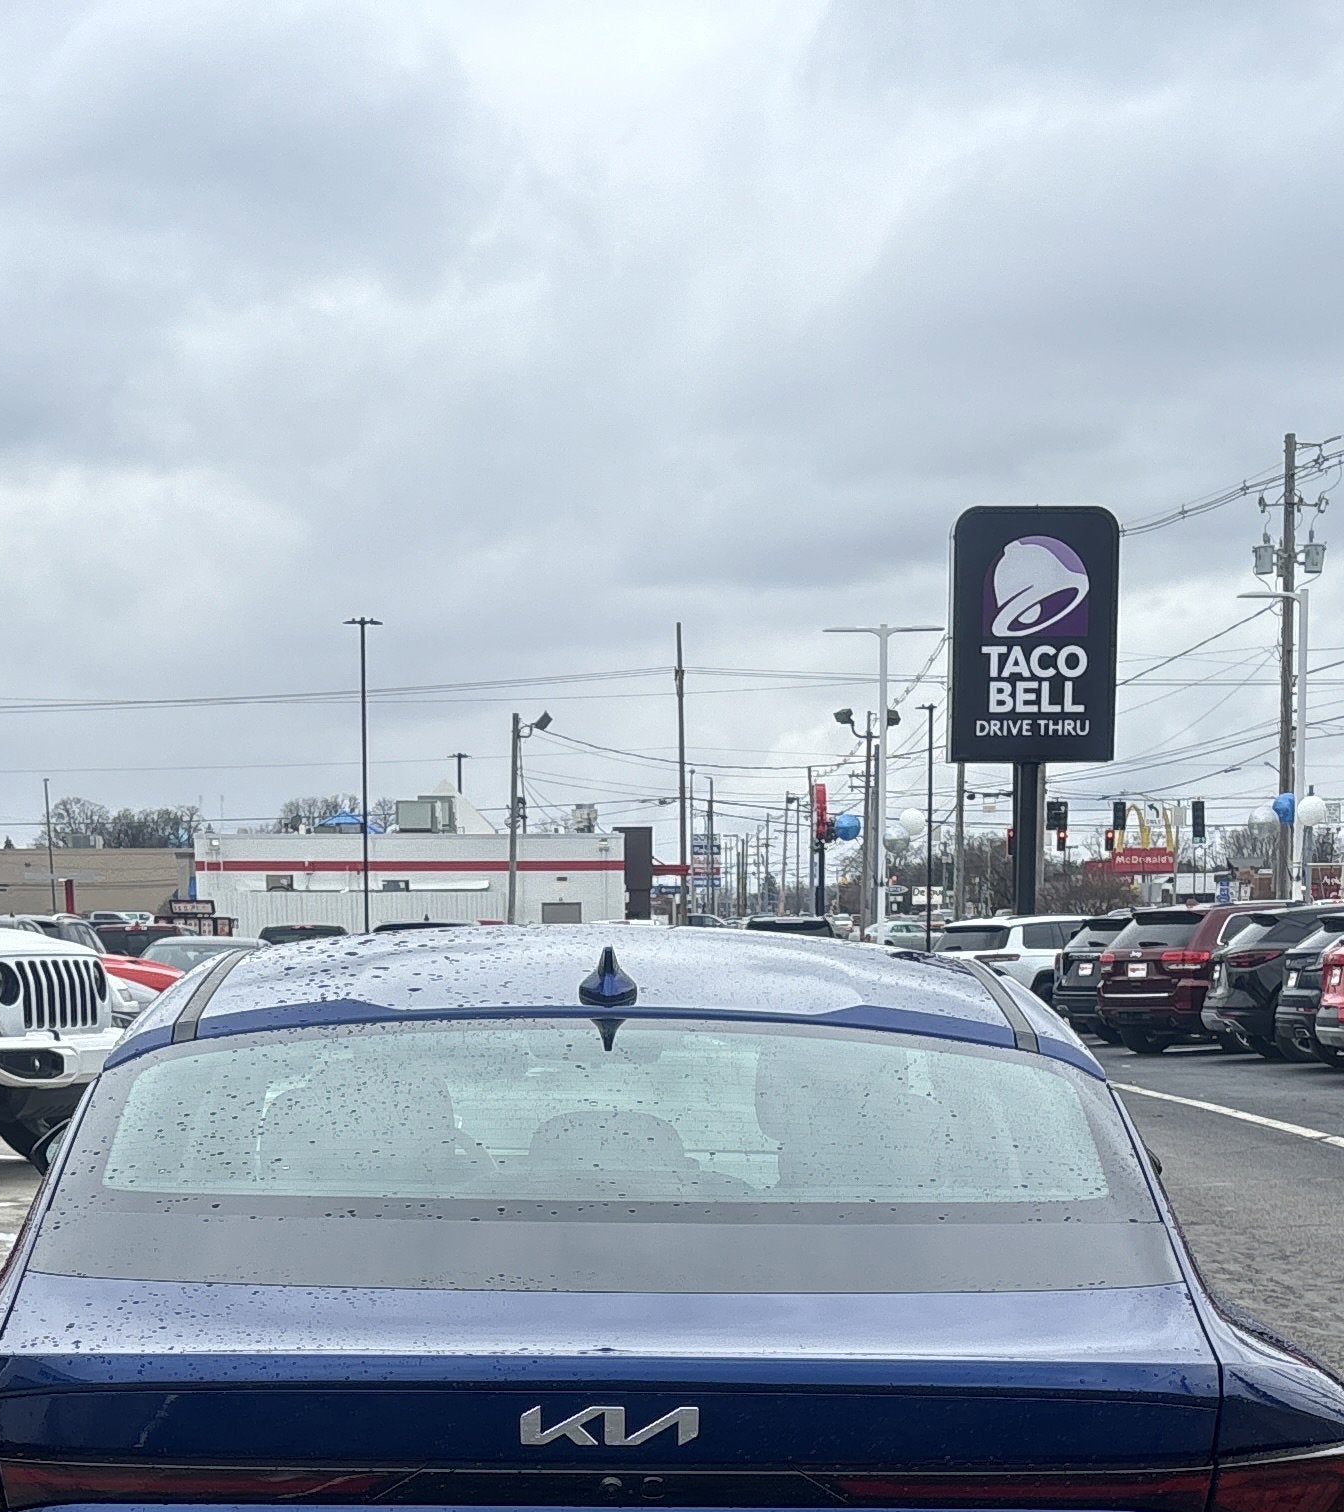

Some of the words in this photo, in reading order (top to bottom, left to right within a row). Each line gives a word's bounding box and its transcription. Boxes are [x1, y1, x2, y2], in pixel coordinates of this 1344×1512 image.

[981, 645, 1088, 678] TACO
[988, 681, 1085, 713] BELL
[976, 720, 1033, 736] DRIVE
[1037, 720, 1090, 736] THRU
[1116, 855, 1174, 864] McDonald's
[520, 1405, 699, 1446] KIA
